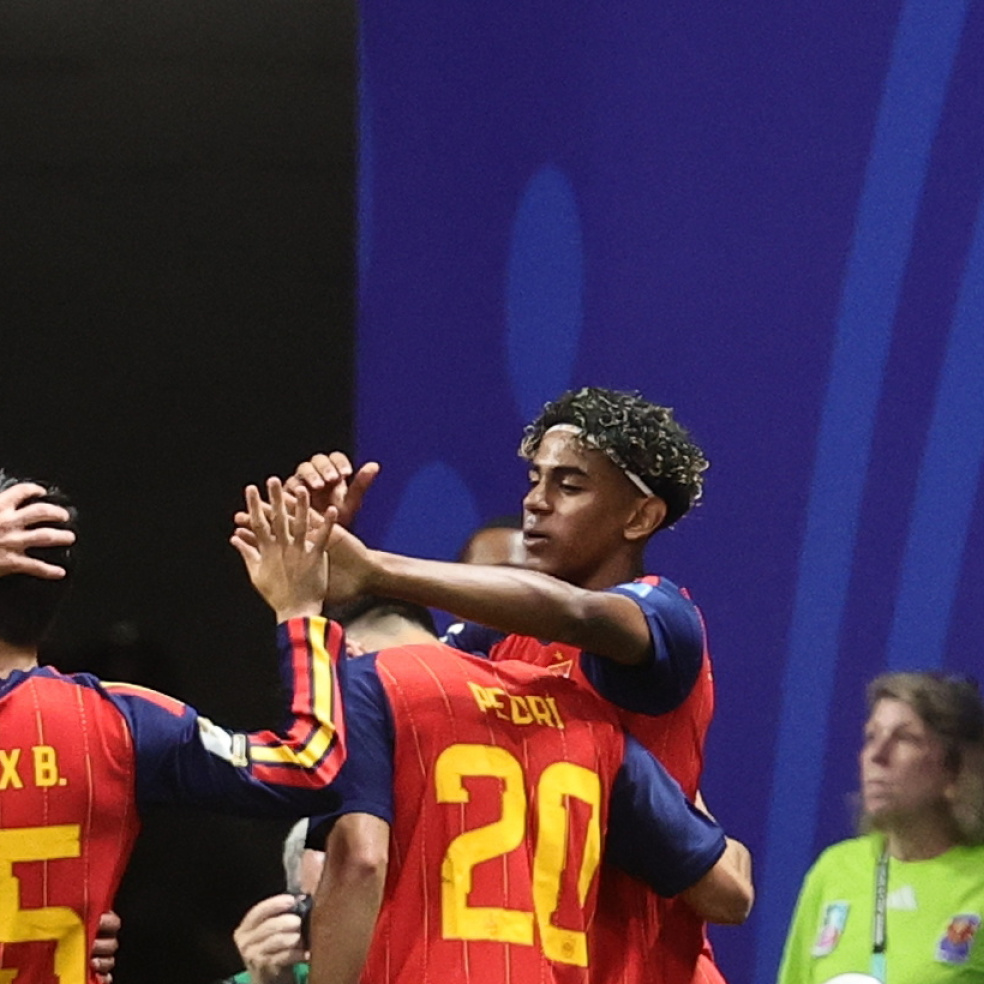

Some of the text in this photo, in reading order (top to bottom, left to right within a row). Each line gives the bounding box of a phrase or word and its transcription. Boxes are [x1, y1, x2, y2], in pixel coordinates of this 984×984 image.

[467, 681, 565, 729] PEDRI
[31, 745, 67, 787] B.
[435, 743, 601, 967] 20
